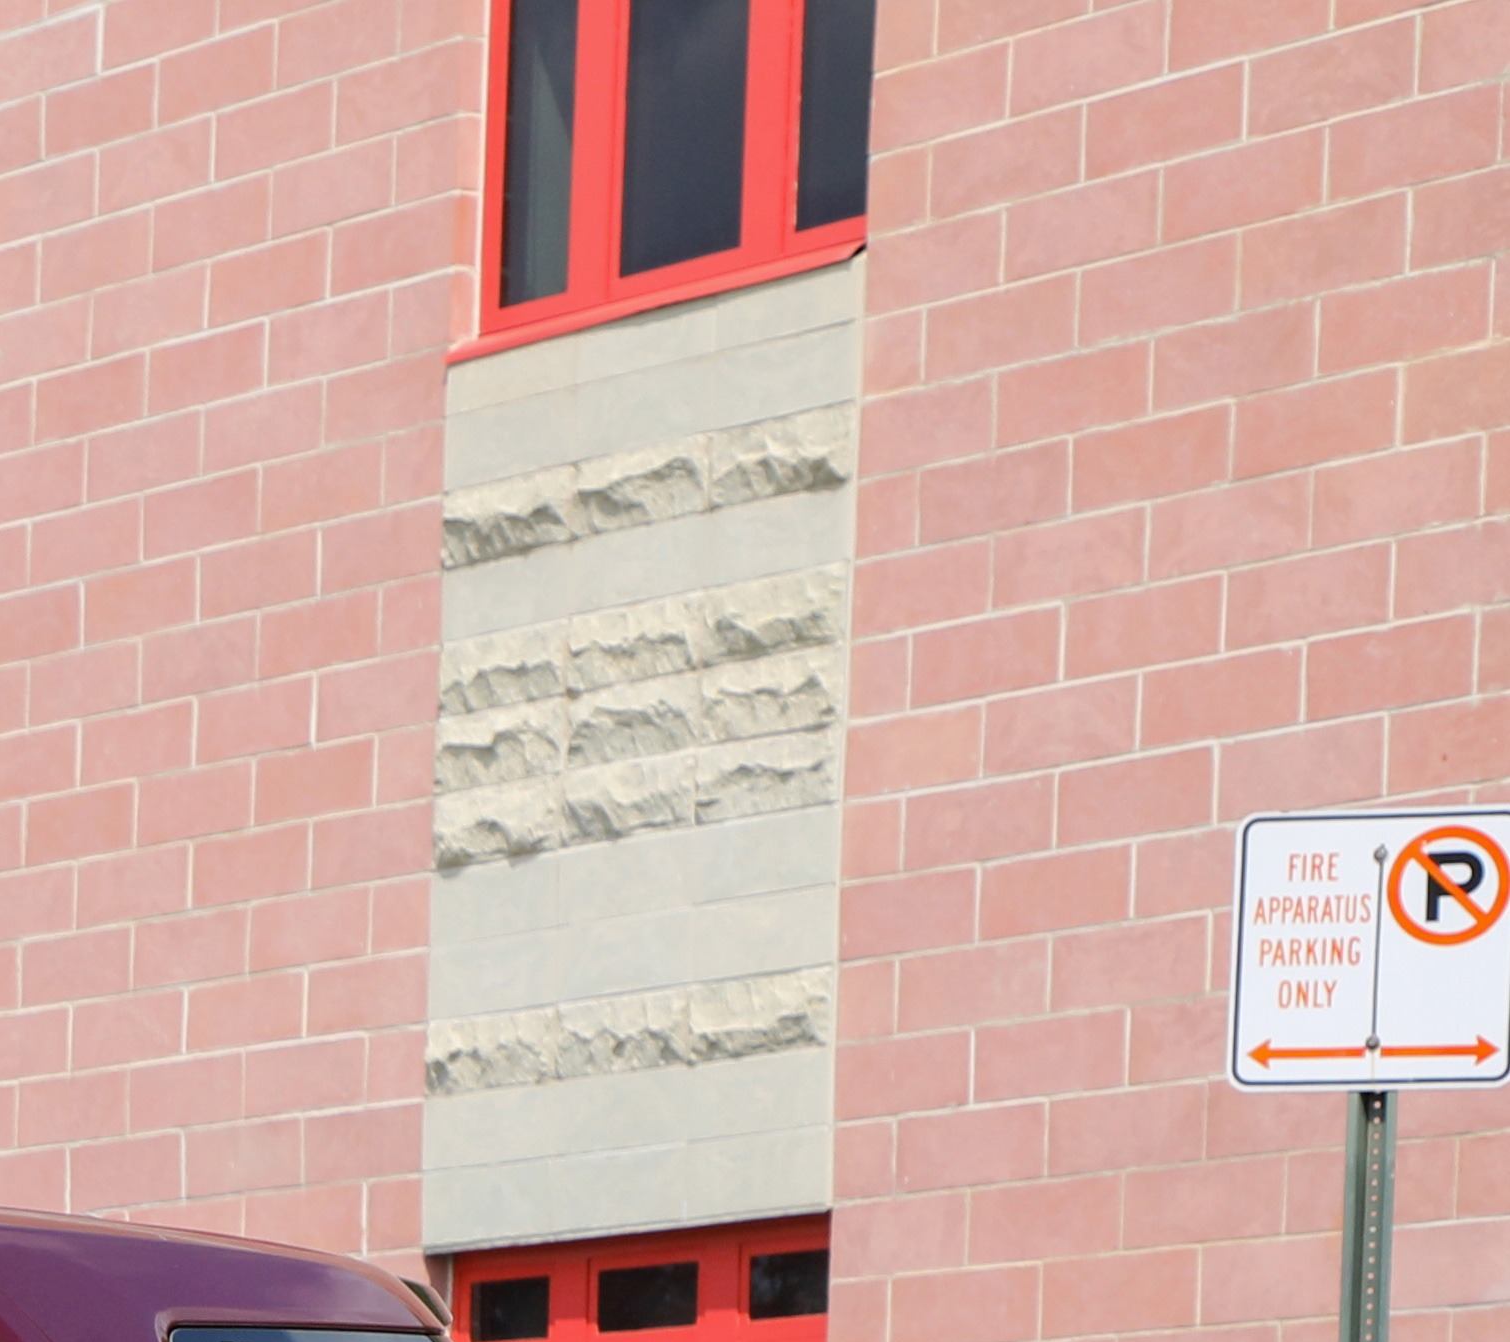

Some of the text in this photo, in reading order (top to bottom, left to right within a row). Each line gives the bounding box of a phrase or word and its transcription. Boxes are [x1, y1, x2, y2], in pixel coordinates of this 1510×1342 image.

[1287, 851, 1340, 882] FIRE
[1253, 893, 1372, 927] APPARATUS
[1257, 936, 1362, 968] PARKING
[1277, 979, 1339, 1010] ONLY
